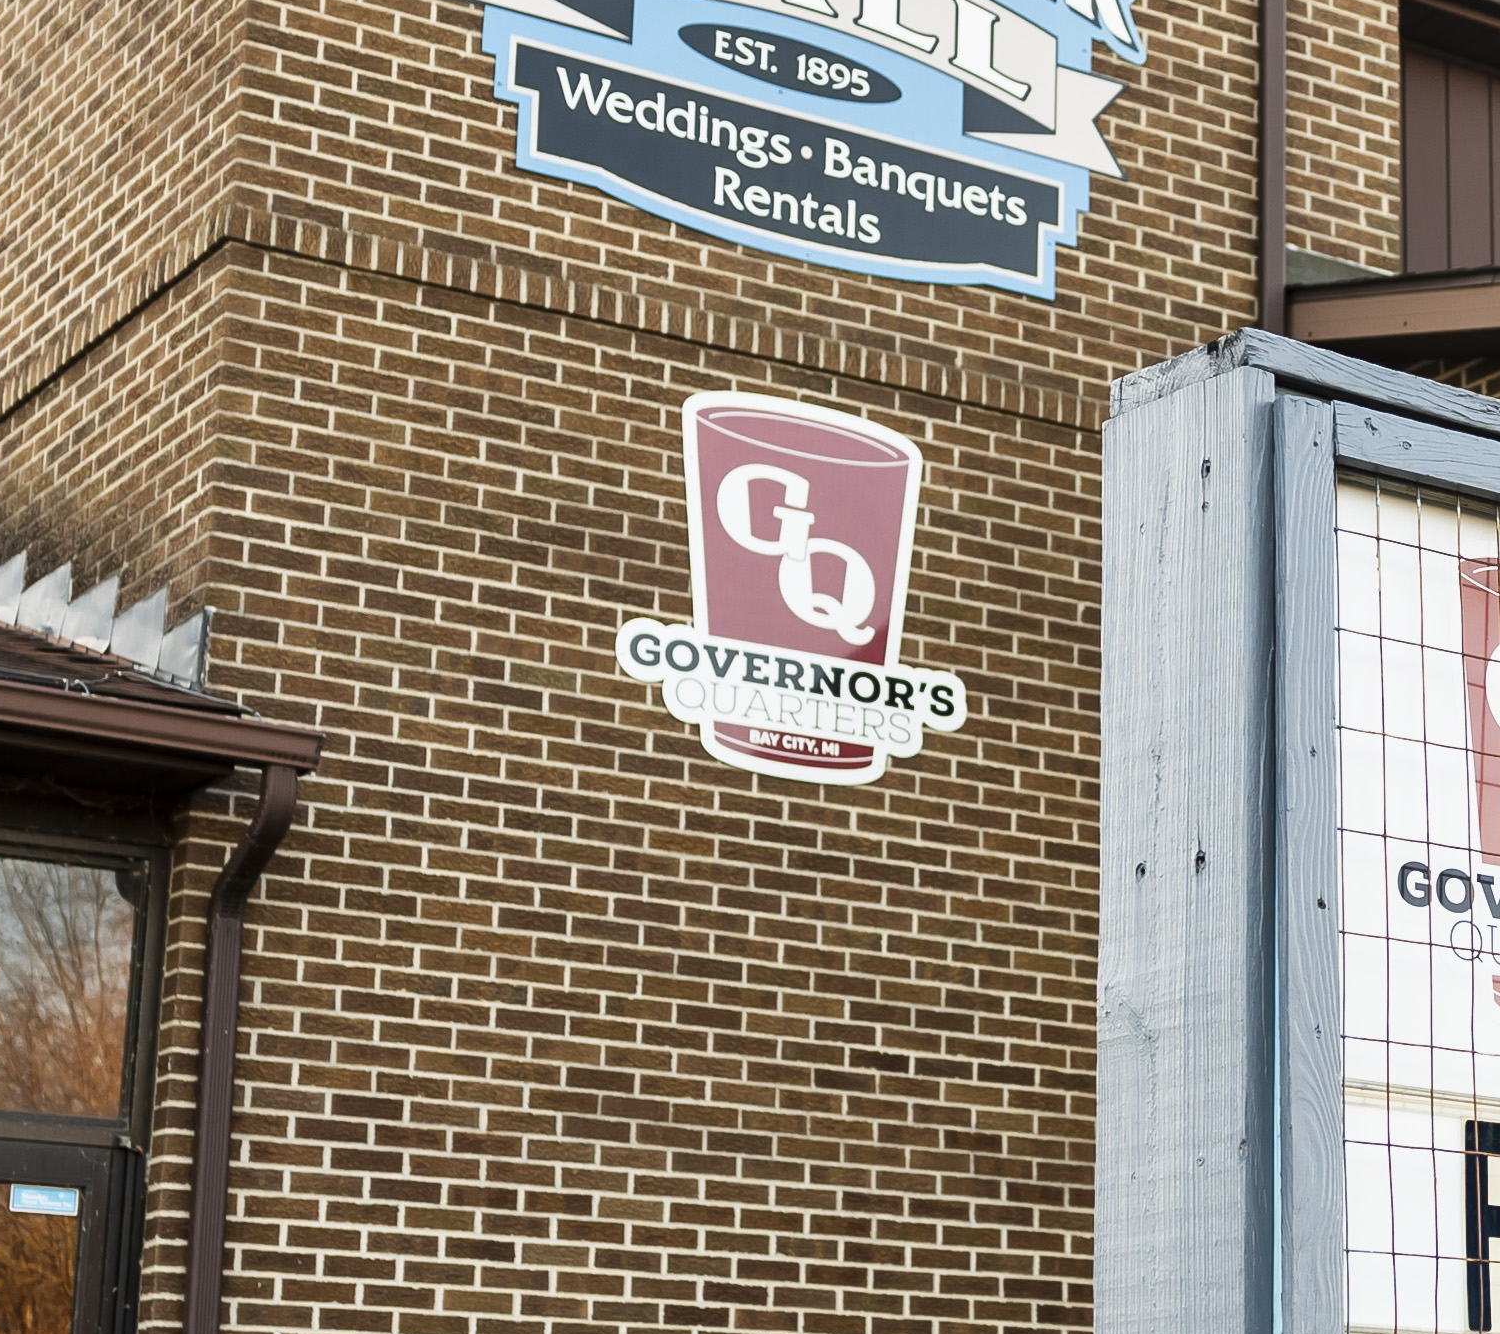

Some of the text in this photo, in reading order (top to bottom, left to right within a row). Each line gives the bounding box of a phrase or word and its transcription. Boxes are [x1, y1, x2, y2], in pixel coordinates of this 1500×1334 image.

[713, 30, 871, 97] EST. 1895
[555, 66, 1028, 227] Weddings Banquets
[713, 165, 881, 245] Rentals
[716, 463, 876, 645] GQ
[629, 633, 955, 717] GOVERNOR'S
[674, 676, 912, 744] QUARTERS
[749, 729, 841, 757] BAY CITY, MI
